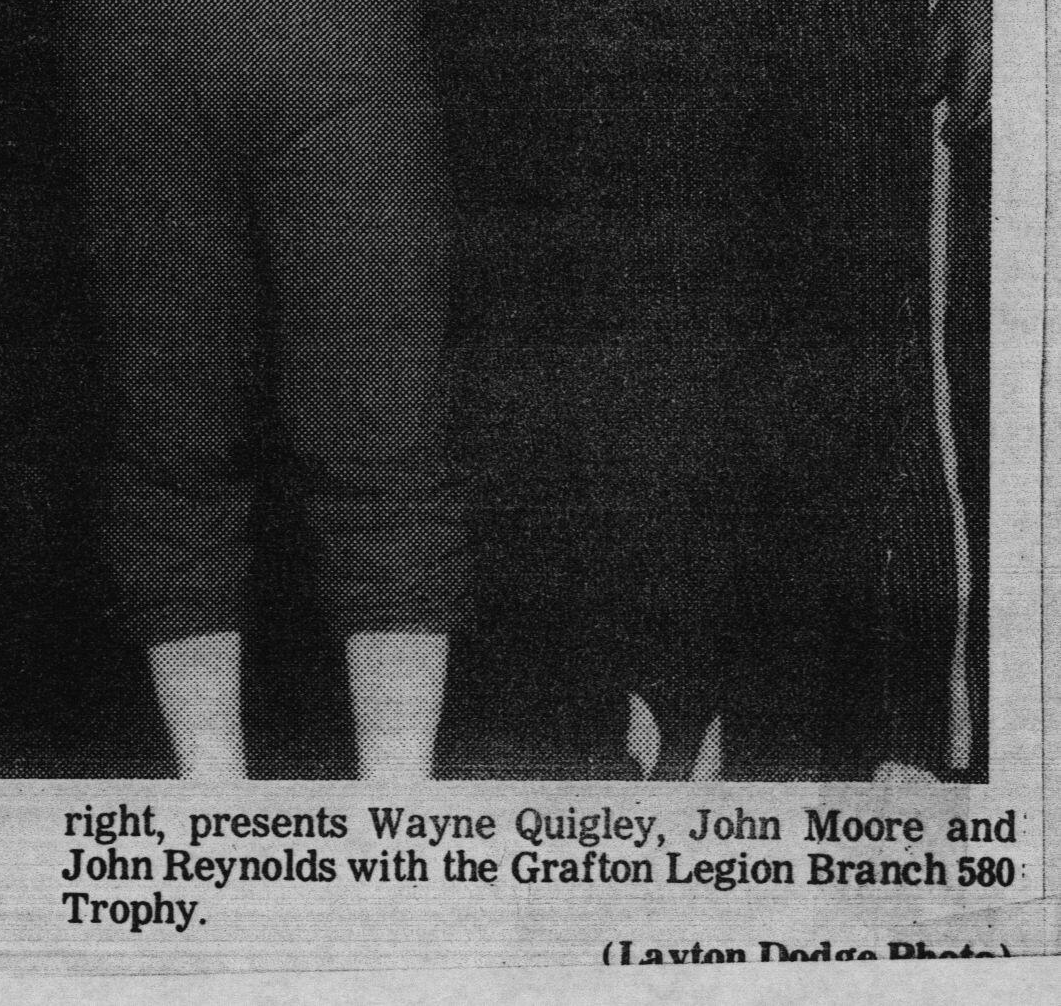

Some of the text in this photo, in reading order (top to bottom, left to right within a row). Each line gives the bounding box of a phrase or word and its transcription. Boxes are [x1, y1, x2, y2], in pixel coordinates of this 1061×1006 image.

[64, 805, 1016, 847] right, presents Wayne Quigley, John Moore and
[62, 848, 1014, 891] John Reynolds with the Grafton Legion Branch 580
[63, 892, 206, 933] Trophy.
